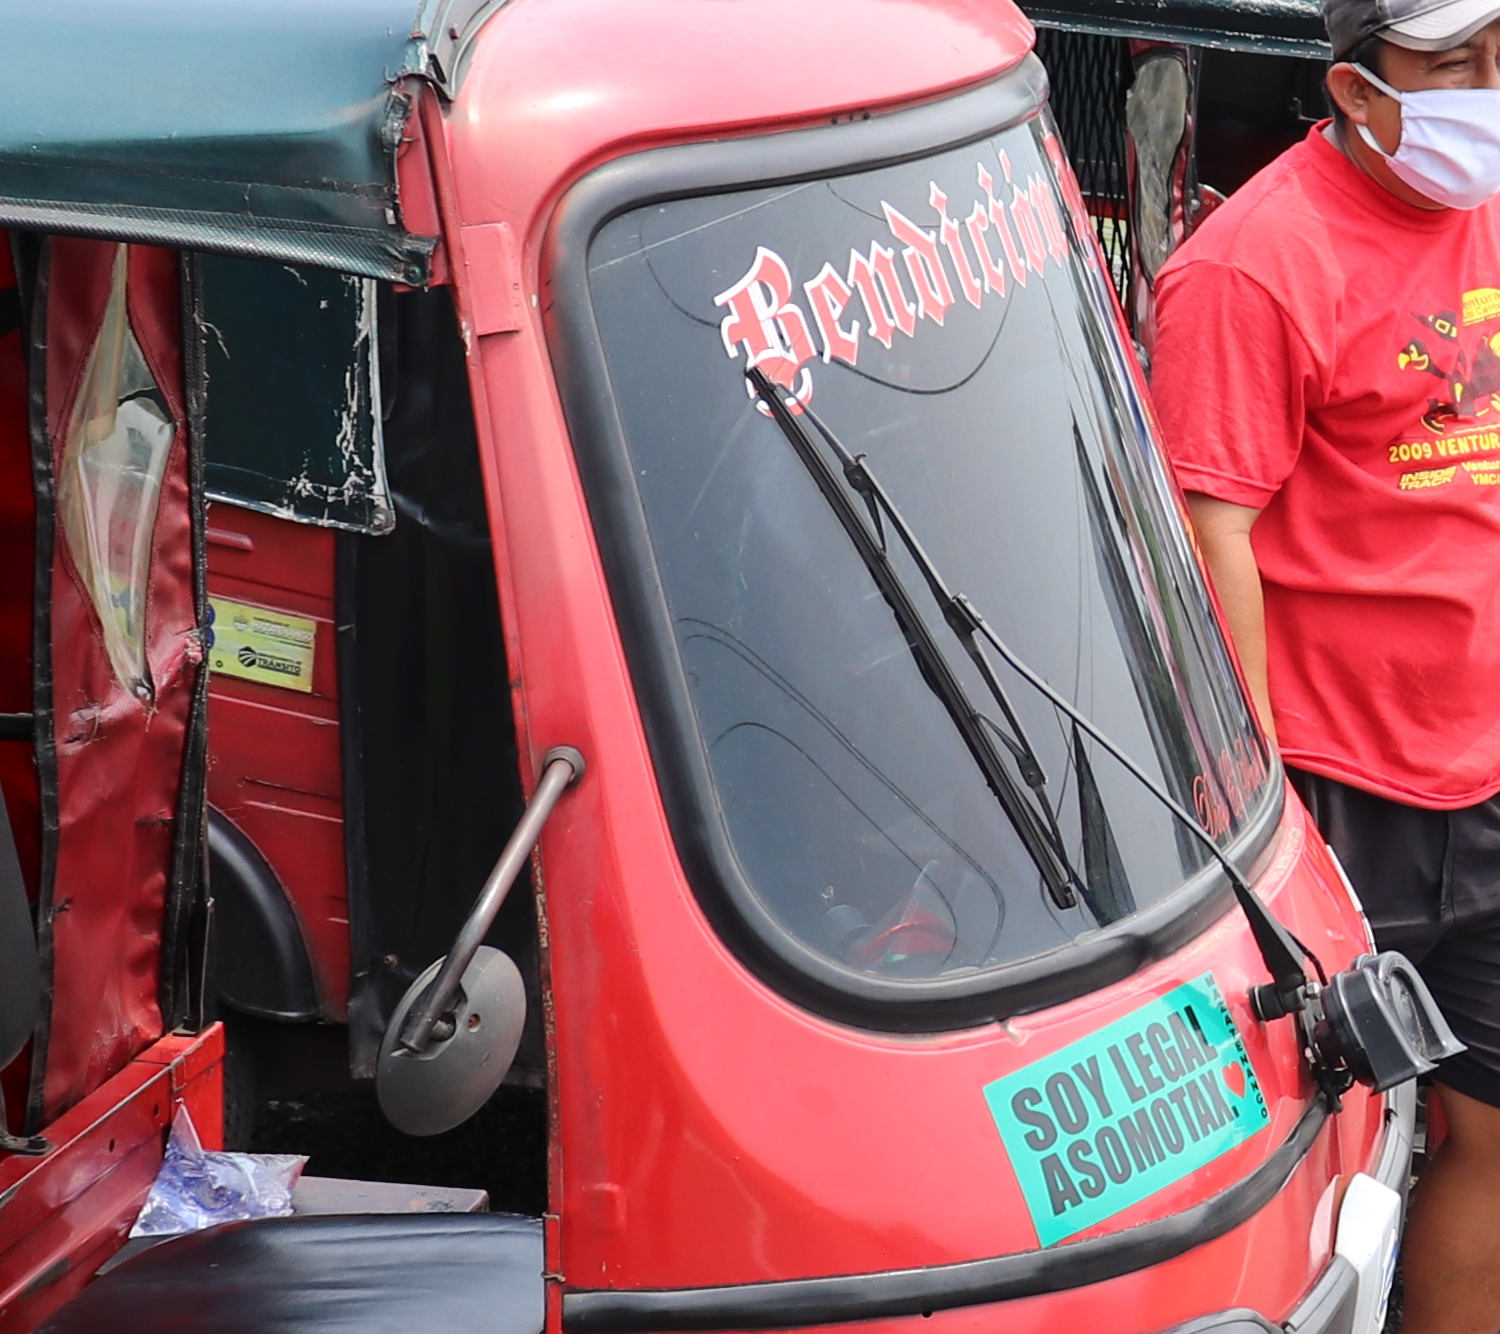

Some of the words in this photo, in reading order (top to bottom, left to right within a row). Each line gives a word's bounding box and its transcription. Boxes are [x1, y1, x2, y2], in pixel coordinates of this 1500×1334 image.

[1388, 442, 1432, 463] 2009
[1398, 474, 1454, 490] TRACK
[1401, 466, 1458, 482] INSIDE
[1011, 1054, 1114, 1152] SOY
[1106, 1004, 1219, 1105] LEGAL
